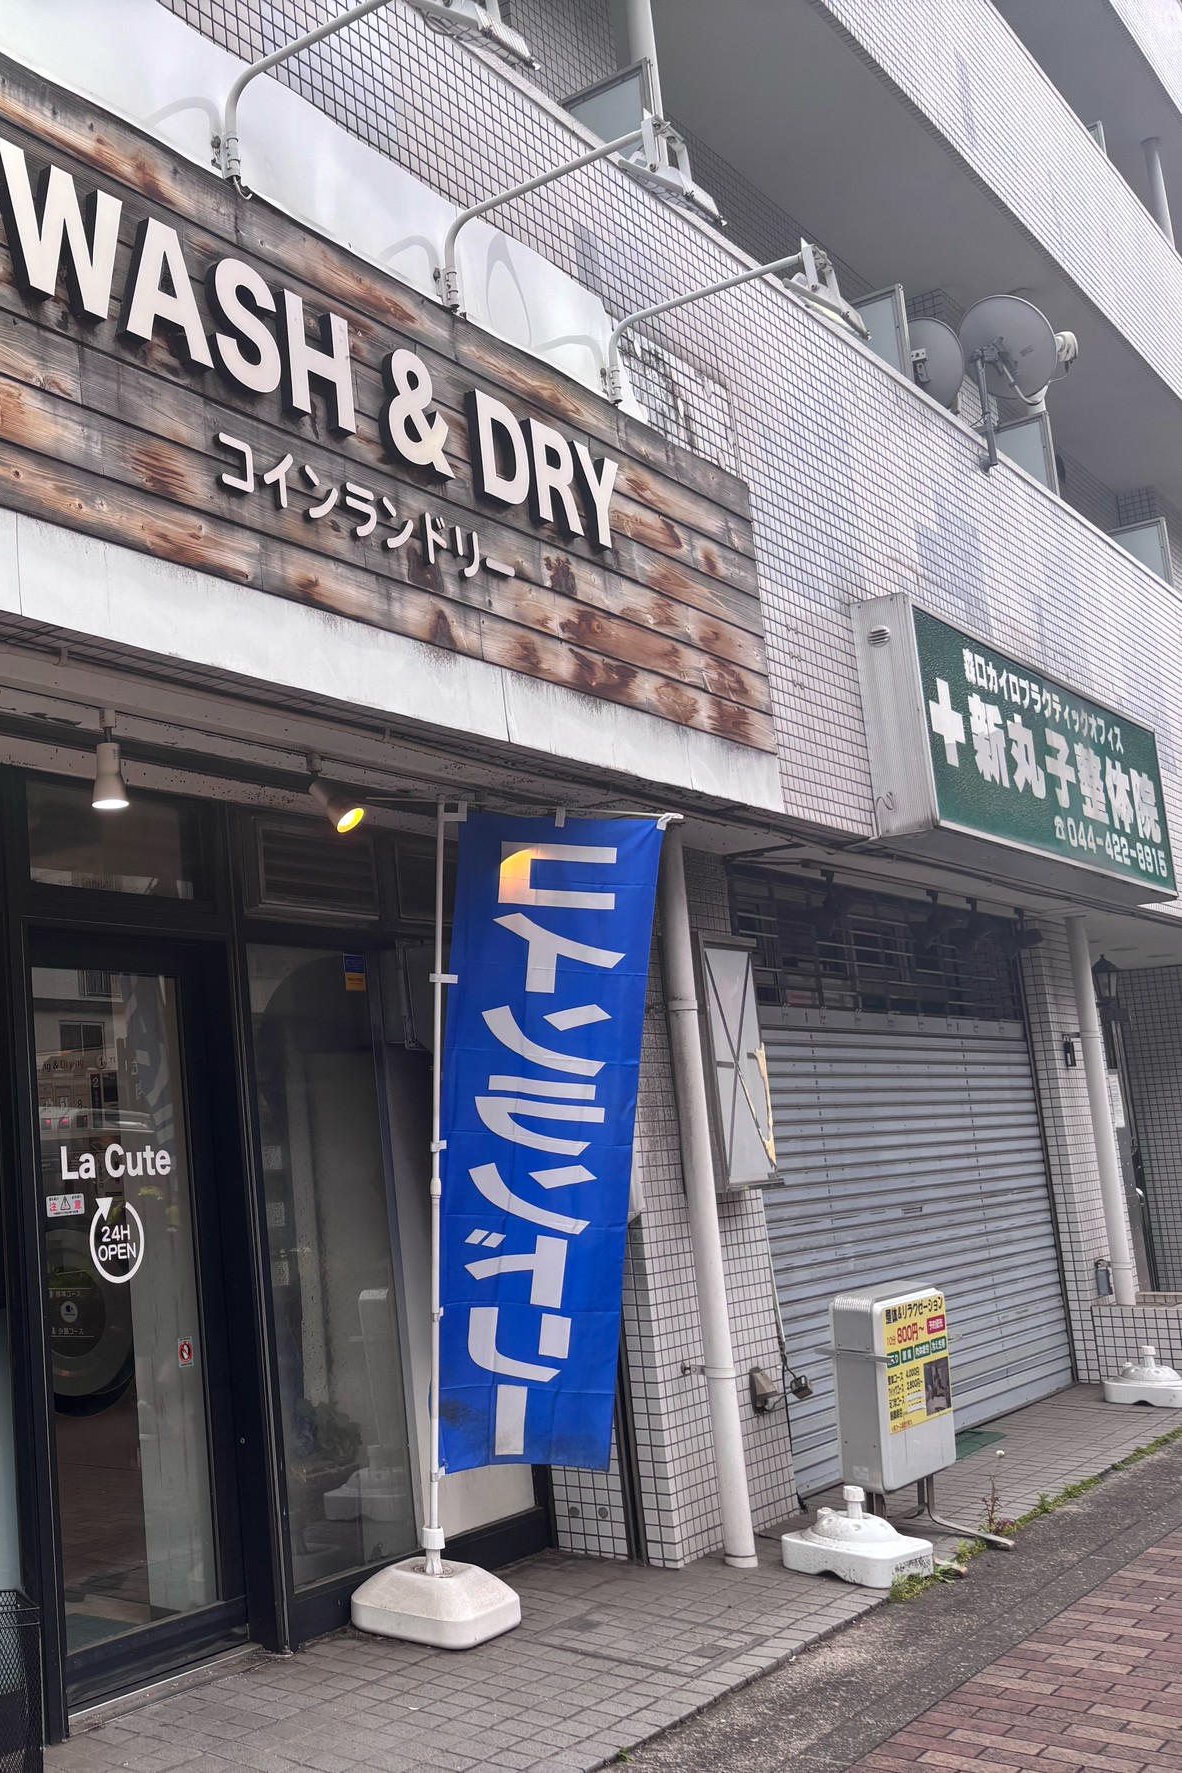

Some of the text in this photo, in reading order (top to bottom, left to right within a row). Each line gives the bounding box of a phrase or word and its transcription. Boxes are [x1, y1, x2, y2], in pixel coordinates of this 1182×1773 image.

[381, 348, 456, 480] &
[465, 388, 618, 550] DRY
[218, 431, 516, 579] コインランドリー
[968, 693, 1162, 844] 新丸子整体院
[1067, 819, 1168, 878] 044-422-8915
[60, 1143, 172, 1181] La Cute
[97, 1242, 137, 1262] OPEN
[101, 1224, 131, 1243] 24H
